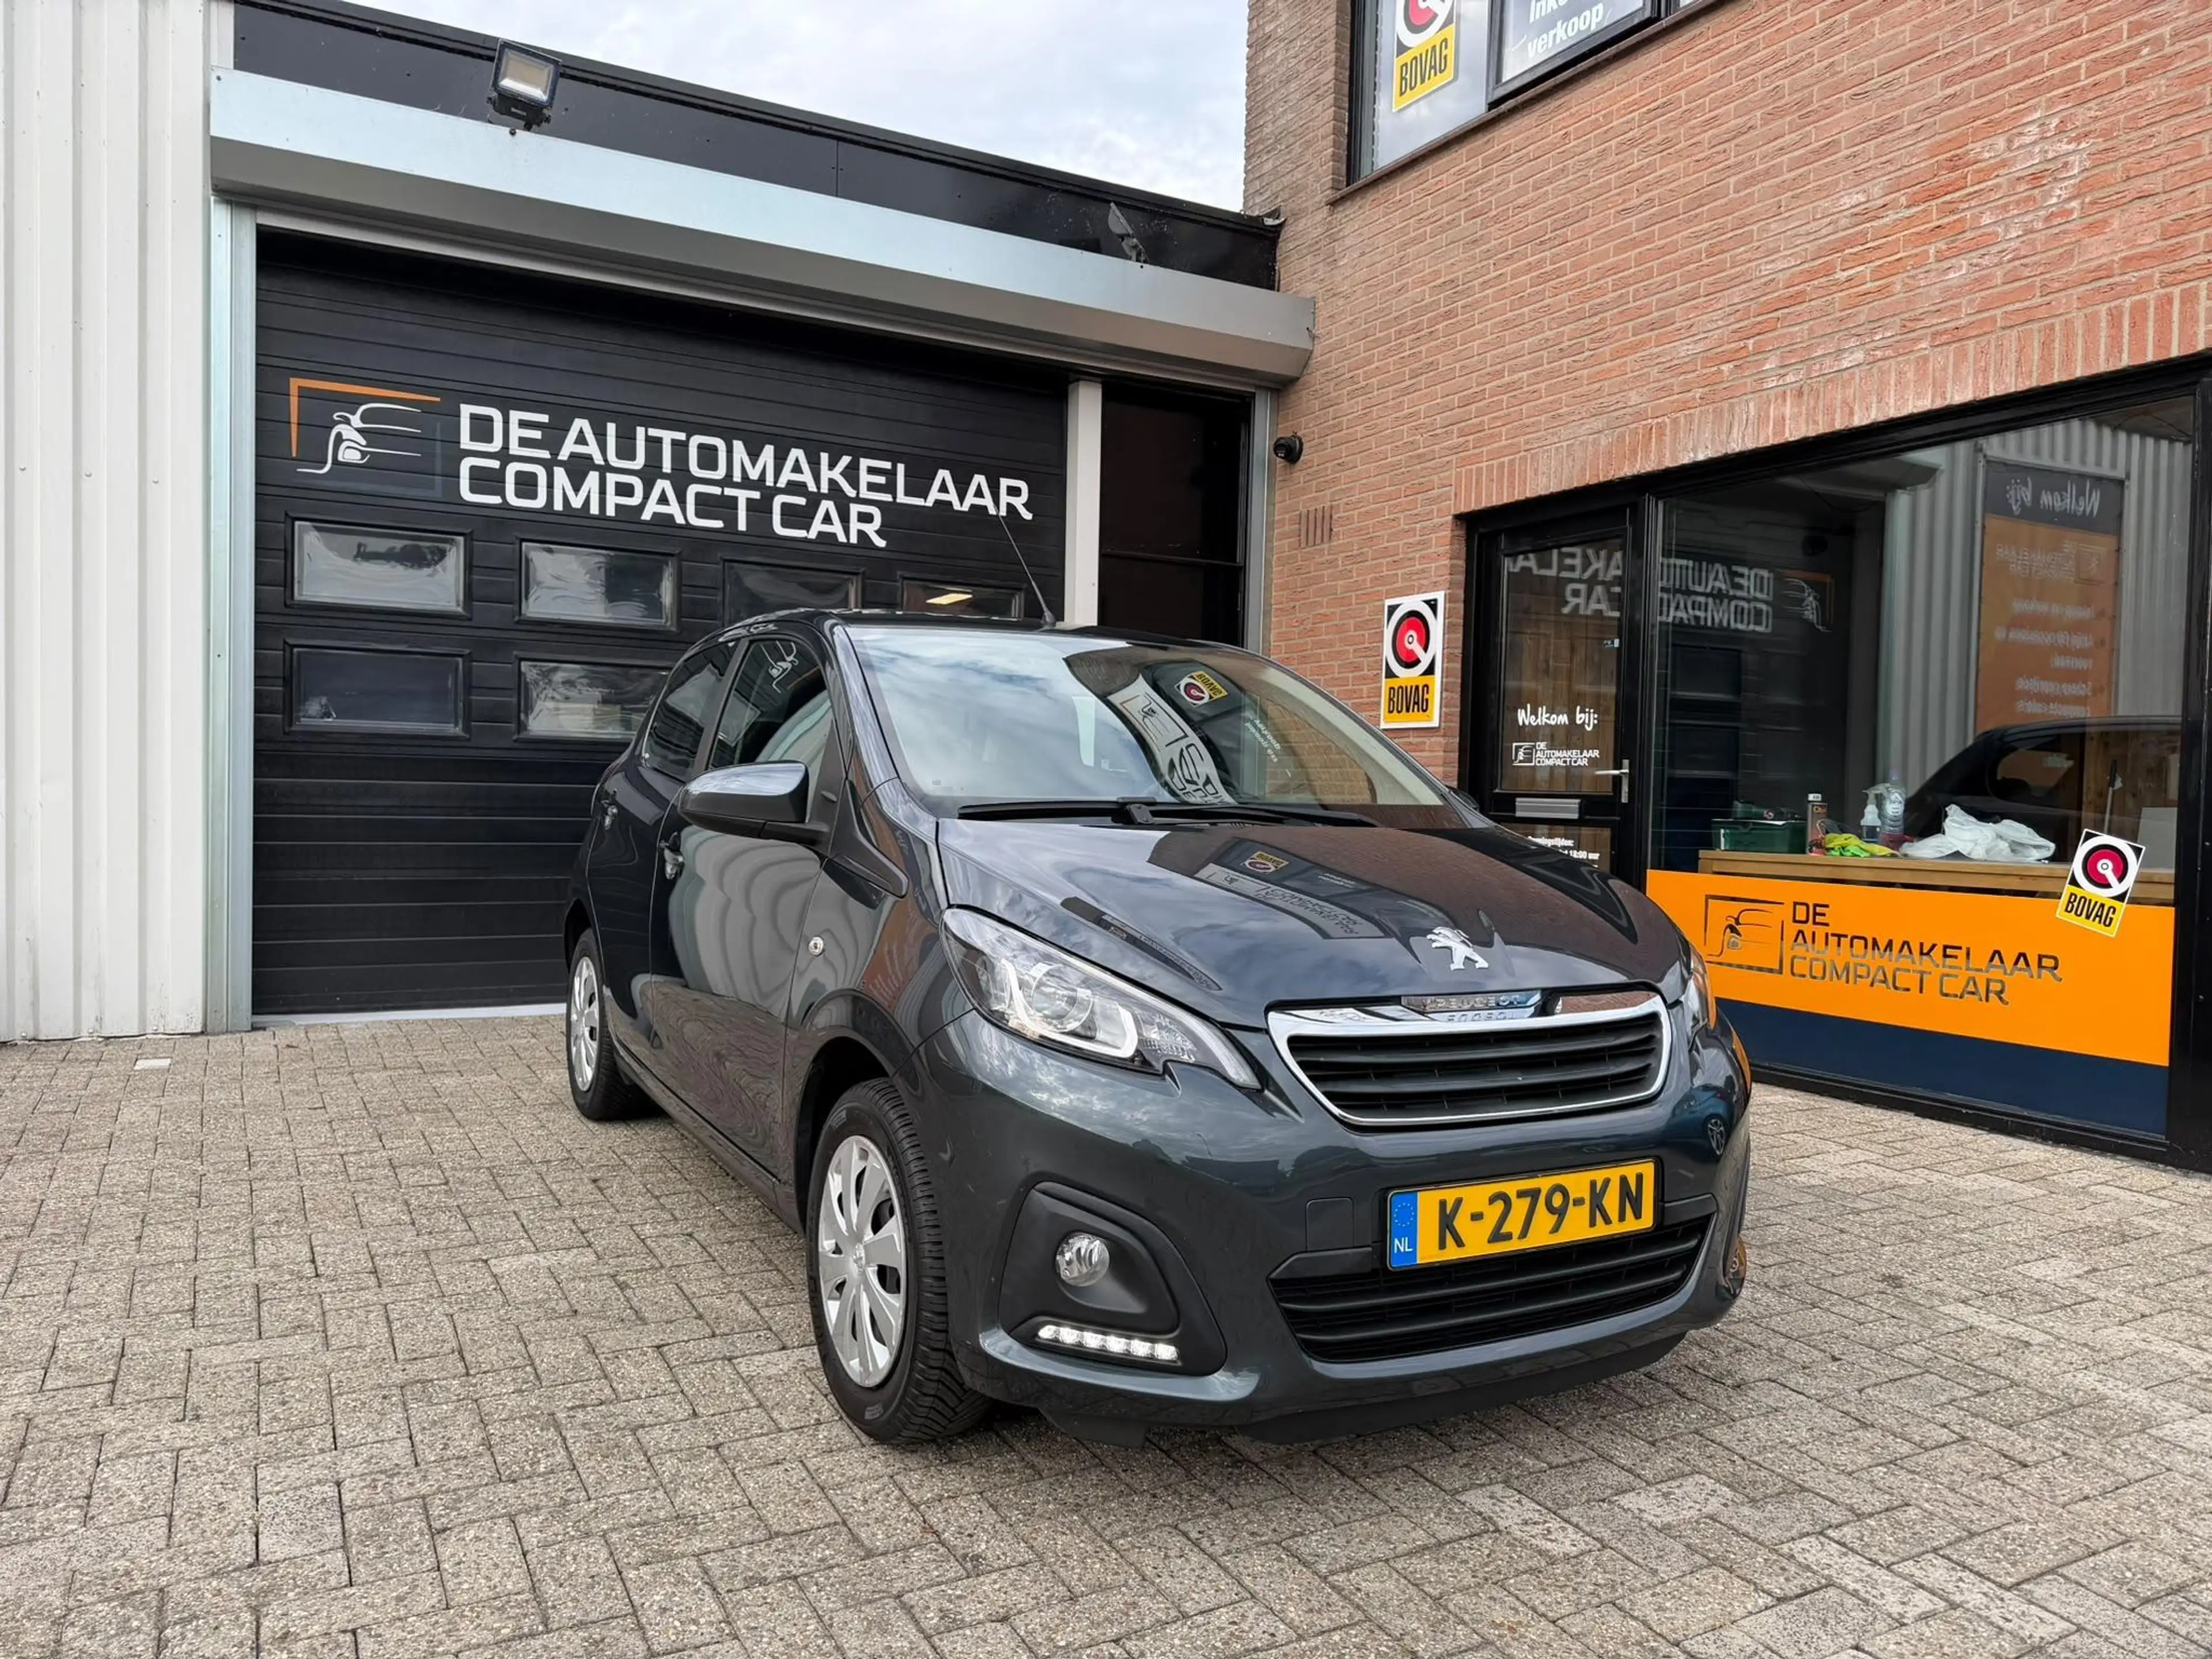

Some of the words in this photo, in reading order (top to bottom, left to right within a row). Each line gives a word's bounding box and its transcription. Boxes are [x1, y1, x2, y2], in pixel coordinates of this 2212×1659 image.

[1529, 0, 1568, 24] Ink
[1528, 2, 1604, 58] verkoop
[1400, 37, 1448, 97] BOVAG
[460, 403, 551, 459] DE
[556, 418, 1033, 520] AUTOMAKELAAR
[460, 457, 761, 531] COMPACT
[772, 494, 887, 548] CAR
[1388, 684, 1429, 714] BOVAG
[1517, 703, 1569, 726] Welkom
[1575, 705, 1599, 731] bij:
[1535, 749, 1600, 758] AUTOMAKELAAR
[1571, 758, 1589, 766] CAR
[1792, 901, 1830, 926] DE
[2065, 892, 2116, 927] BOVAG
[1790, 929, 2062, 982] AUTOMAKELAAR
[1790, 955, 1932, 994] COMPACT
[1938, 973, 2009, 1006] CAR
[1438, 1172, 1643, 1250] K-279-KN
[1394, 1238, 1413, 1253] NL
